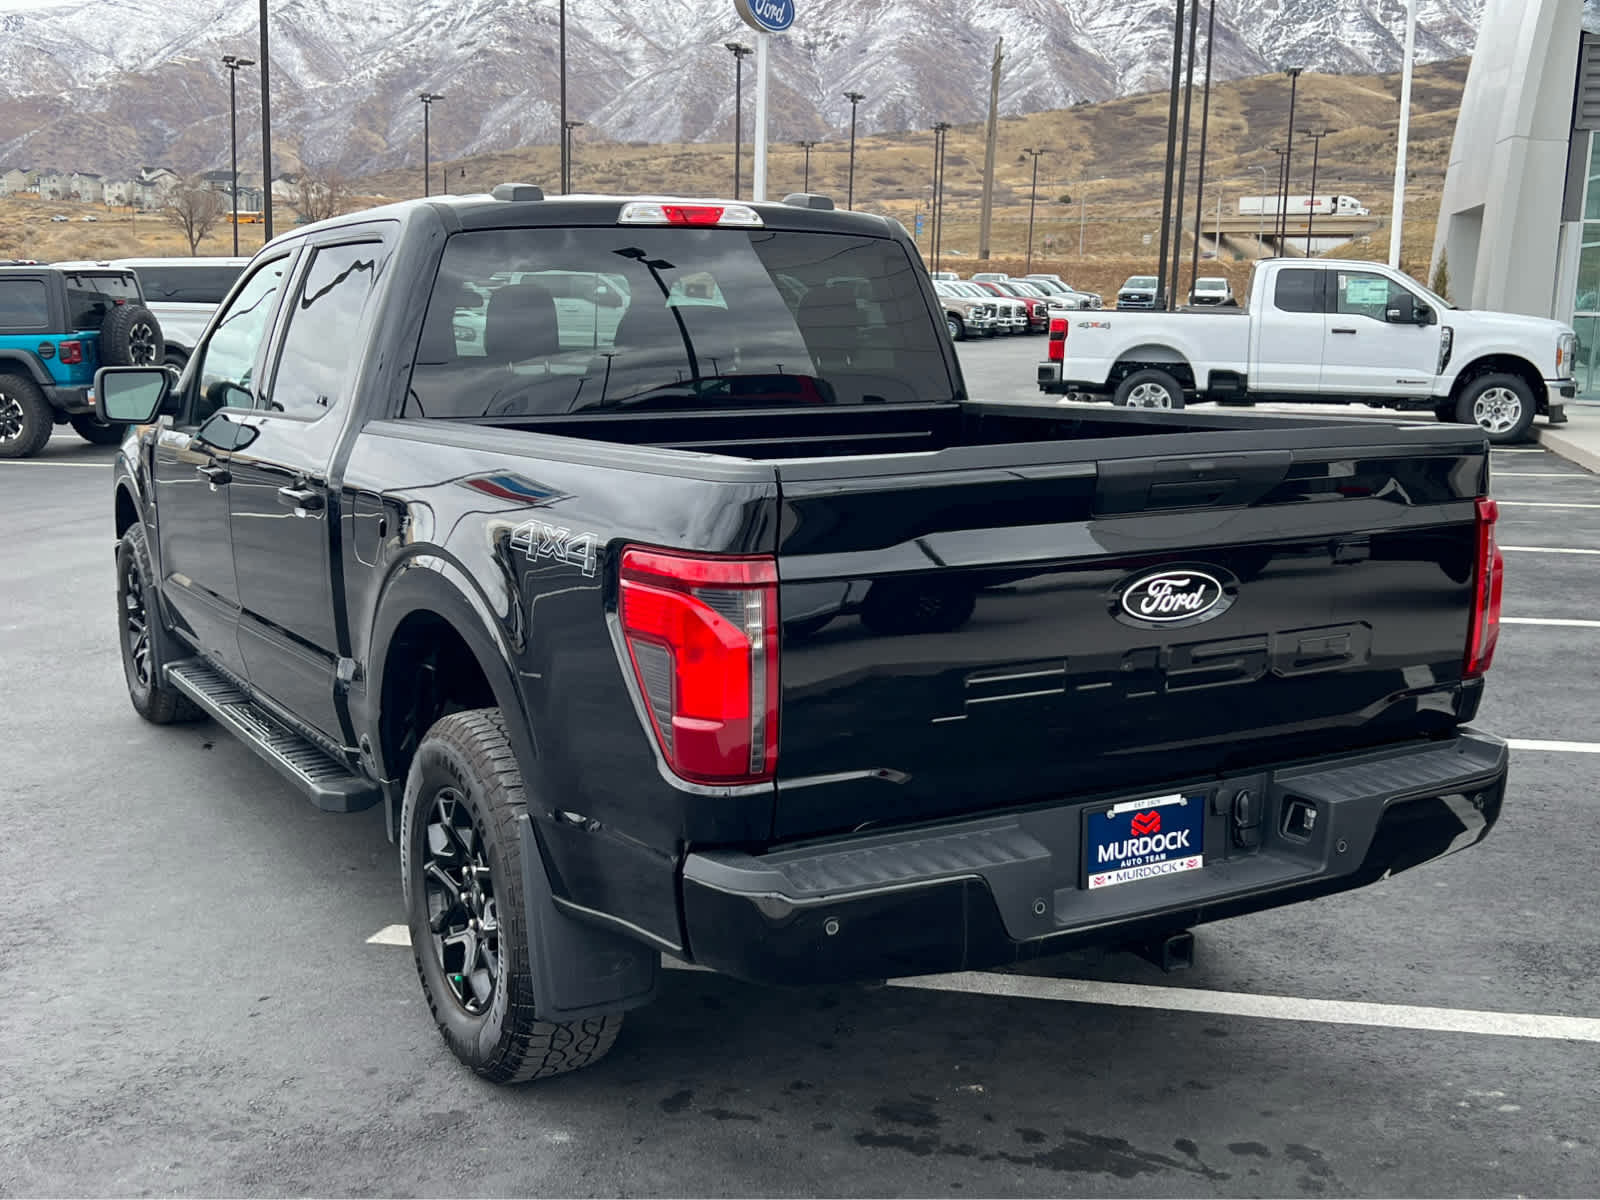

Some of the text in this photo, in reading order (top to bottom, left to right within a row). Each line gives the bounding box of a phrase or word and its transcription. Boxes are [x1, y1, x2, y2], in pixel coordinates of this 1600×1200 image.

[1140, 578, 1206, 614] Ford
[1098, 829, 1190, 863] MURDOCK
[1116, 862, 1177, 881] MURDOCK
[1120, 853, 1167, 868] AUTO TEAM
